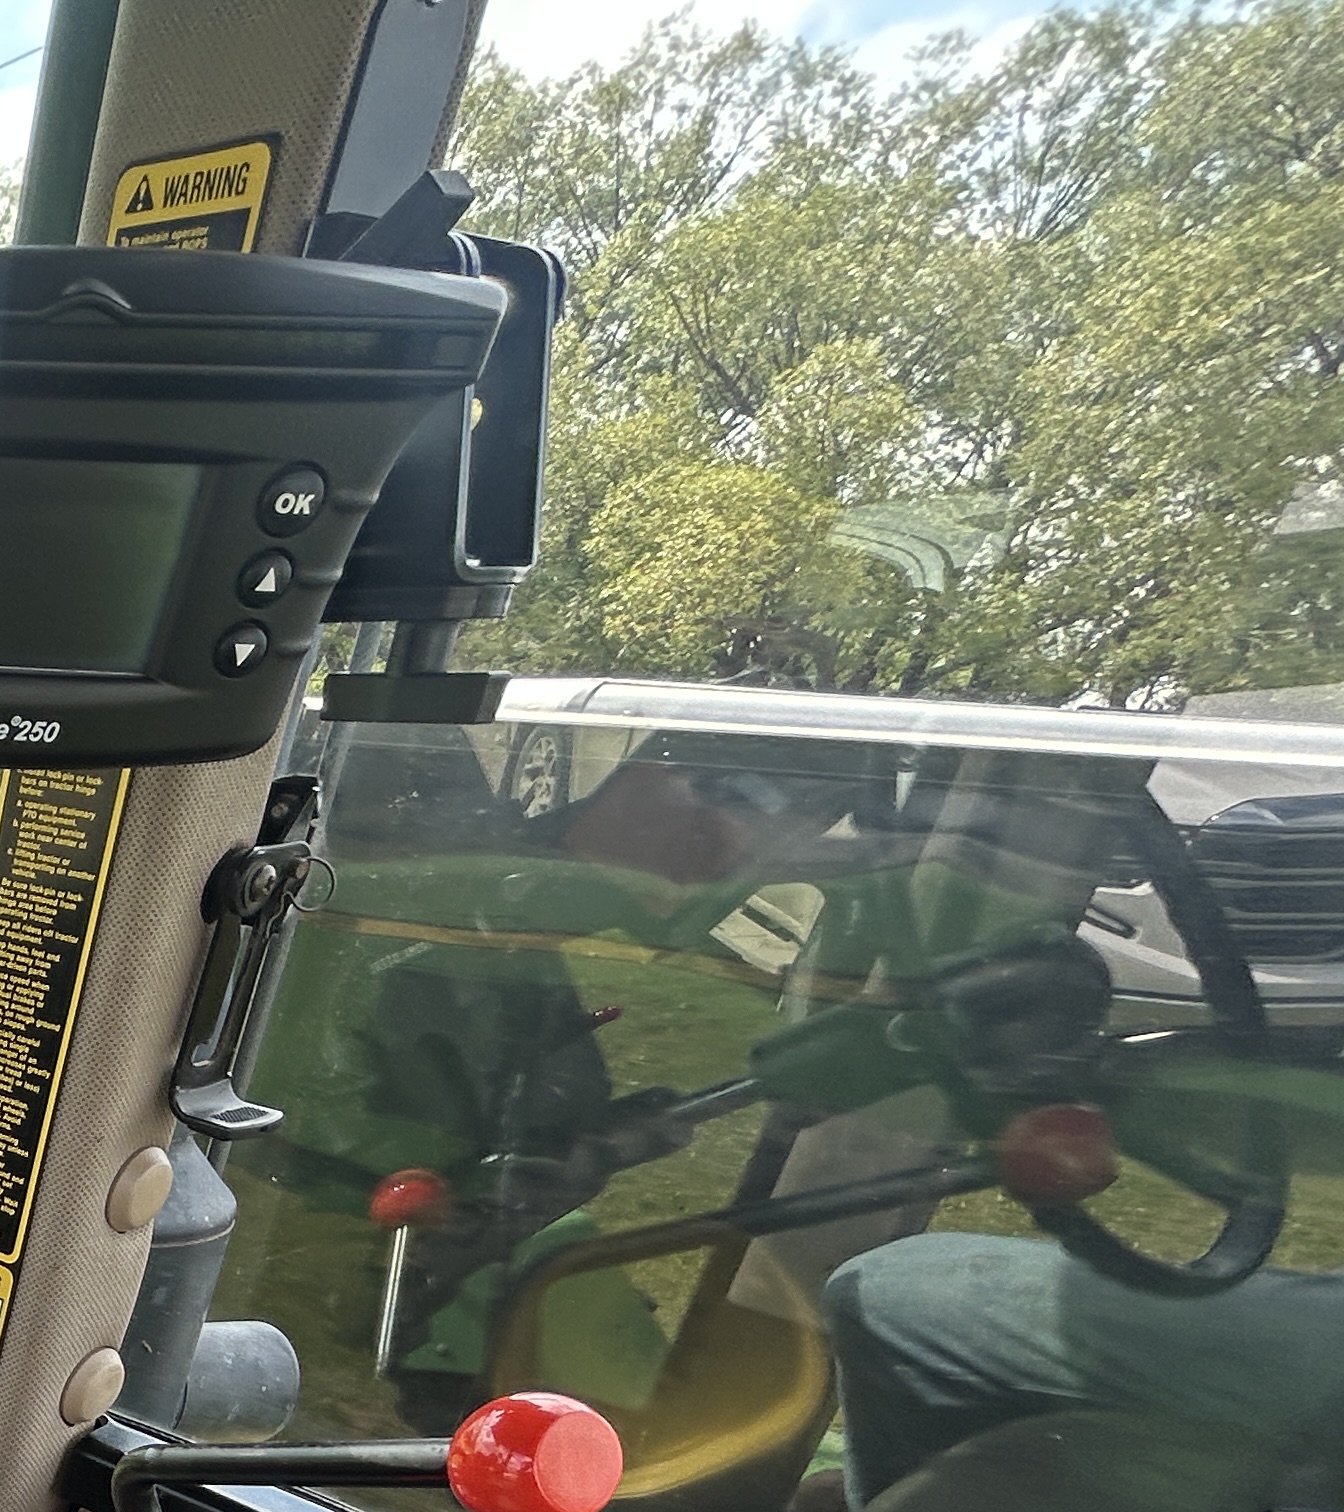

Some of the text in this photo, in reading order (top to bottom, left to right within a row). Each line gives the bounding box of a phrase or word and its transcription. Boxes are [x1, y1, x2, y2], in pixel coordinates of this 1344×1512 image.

[163, 162, 250, 208] WARNING
[171, 225, 210, 240] operator
[275, 492, 315, 515] OK
[13, 721, 61, 743] 250
